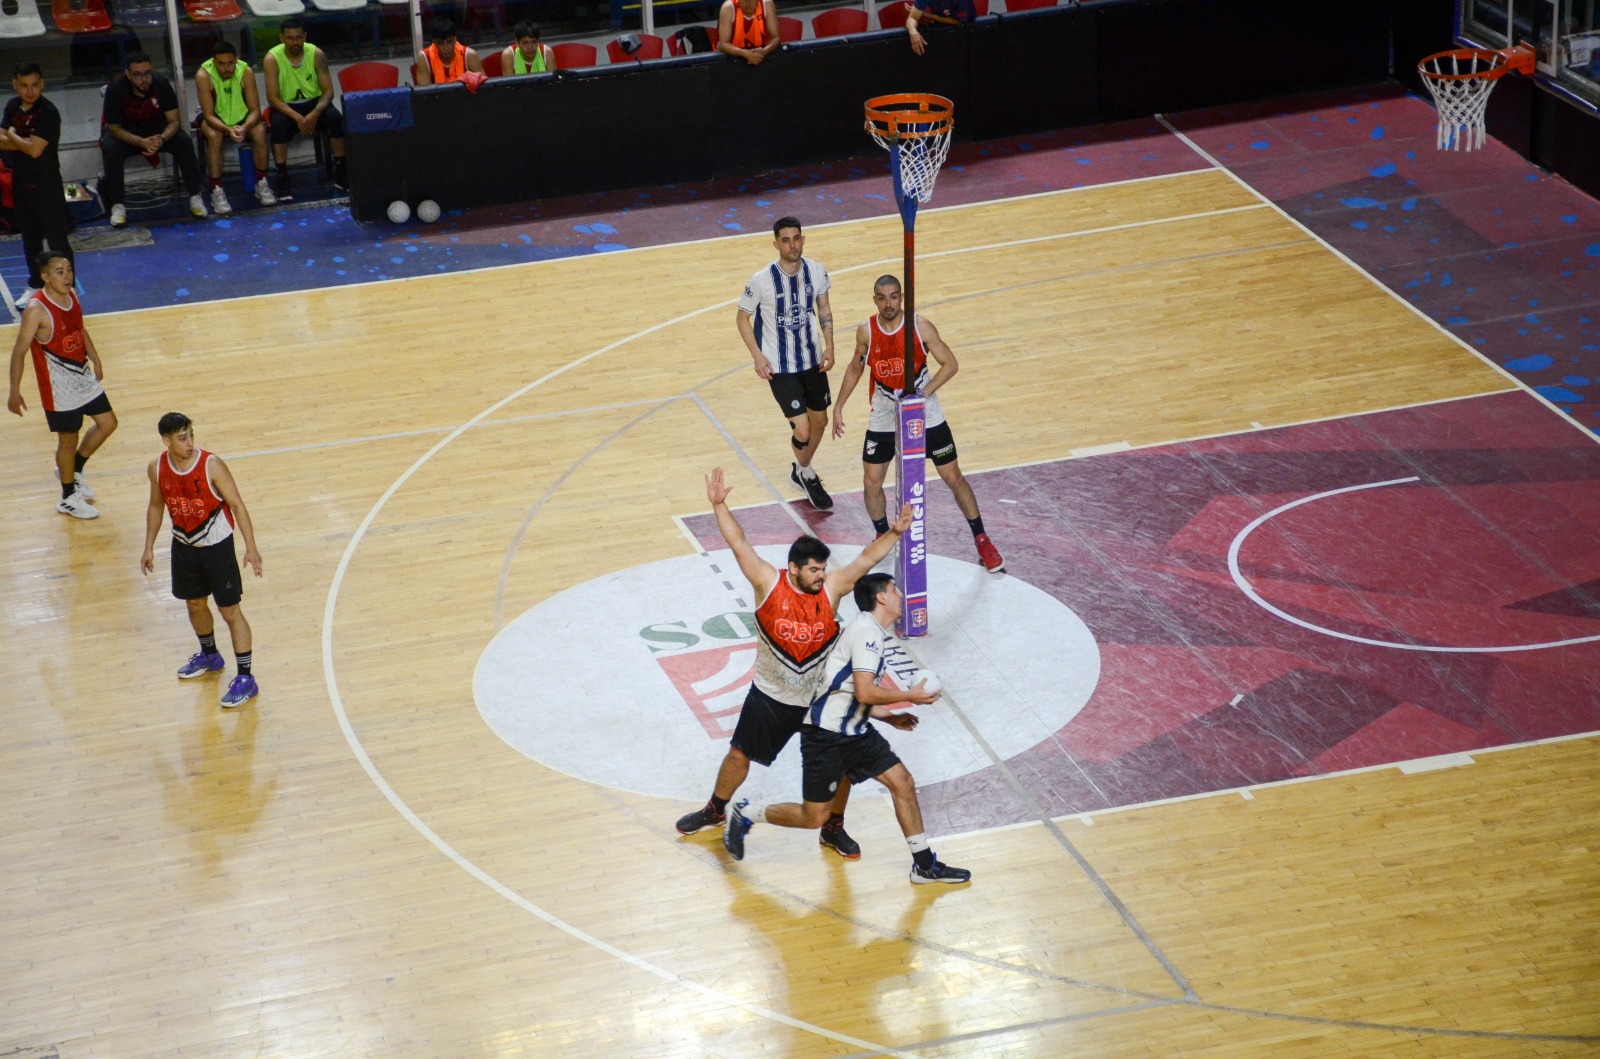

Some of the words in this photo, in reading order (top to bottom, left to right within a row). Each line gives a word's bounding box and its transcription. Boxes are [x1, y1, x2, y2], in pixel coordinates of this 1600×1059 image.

[876, 358, 916, 378] CB
[166, 496, 205, 518] CBC
[774, 618, 825, 644] CBC
